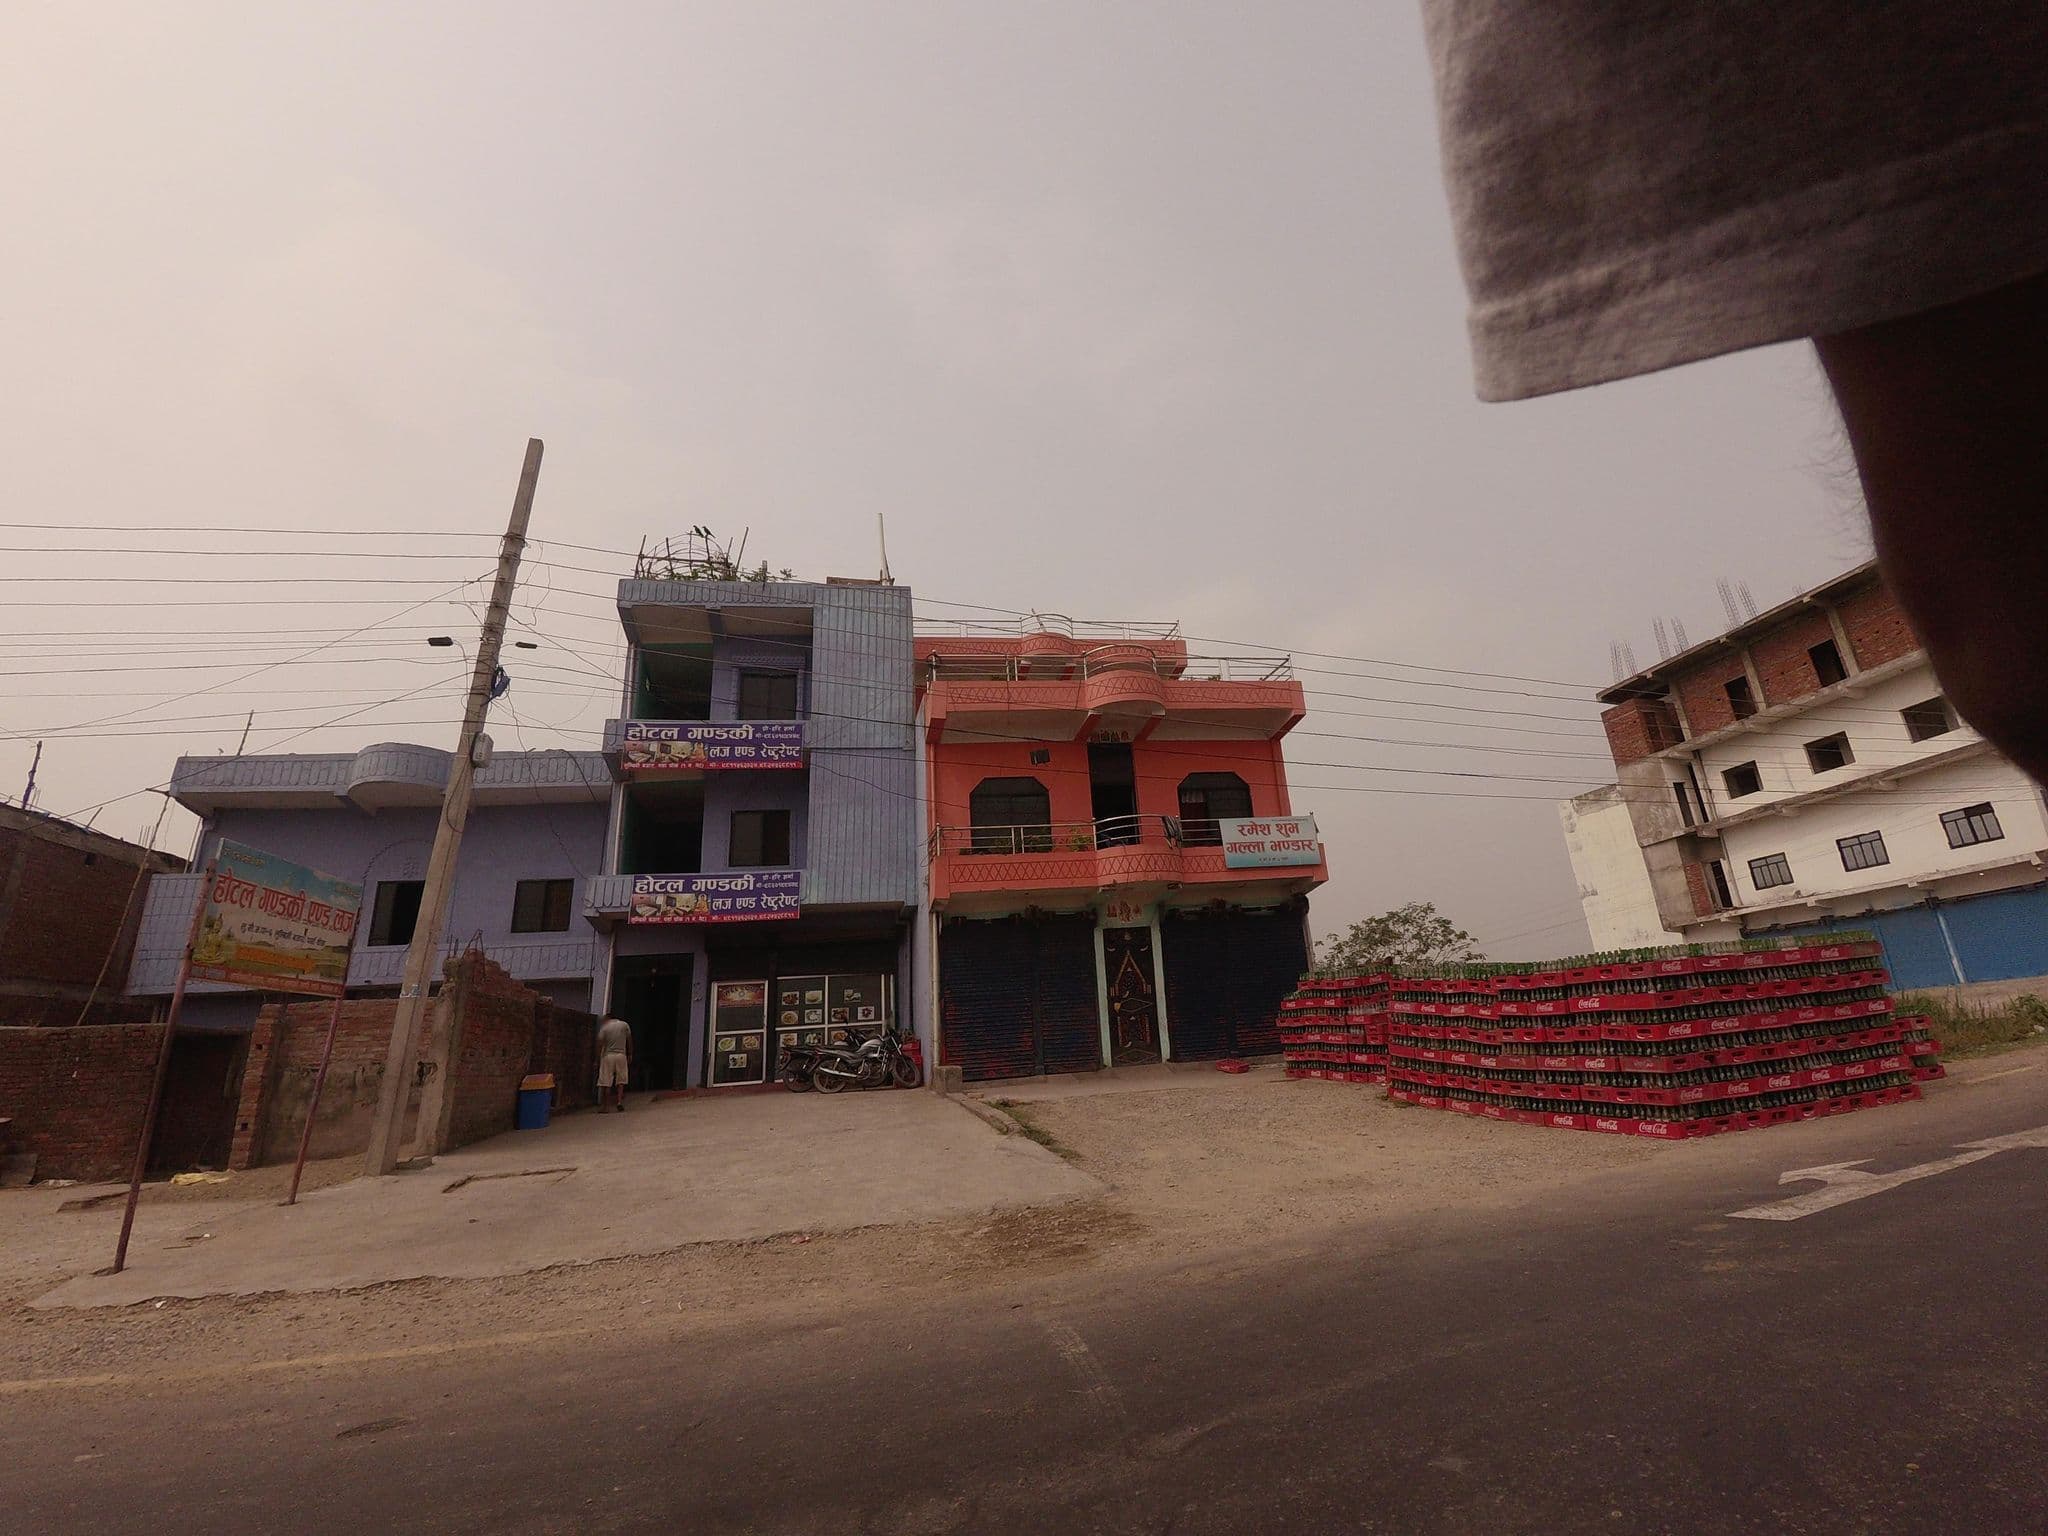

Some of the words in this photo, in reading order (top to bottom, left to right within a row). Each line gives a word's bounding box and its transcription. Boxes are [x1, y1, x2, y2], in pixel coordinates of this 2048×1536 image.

[627, 723, 680, 740] होटल
[688, 724, 755, 740] गण्डकी
[709, 746, 731, 758] लज
[735, 746, 756, 757] एण्ड
[1237, 821, 1272, 836] रमेश
[1275, 822, 1300, 838] शुभ
[1226, 841, 1265, 854] गल्ला
[1270, 839, 1315, 852] भण्डार
[635, 875, 685, 894] होटल
[691, 873, 756, 892] गण्डकी
[212, 869, 258, 910] होटल
[258, 889, 307, 918] गण्डकी
[308, 901, 333, 926] एण्ड
[333, 909, 356, 934] लज
[712, 897, 733, 911] लज
[736, 897, 757, 910] एण्ड
